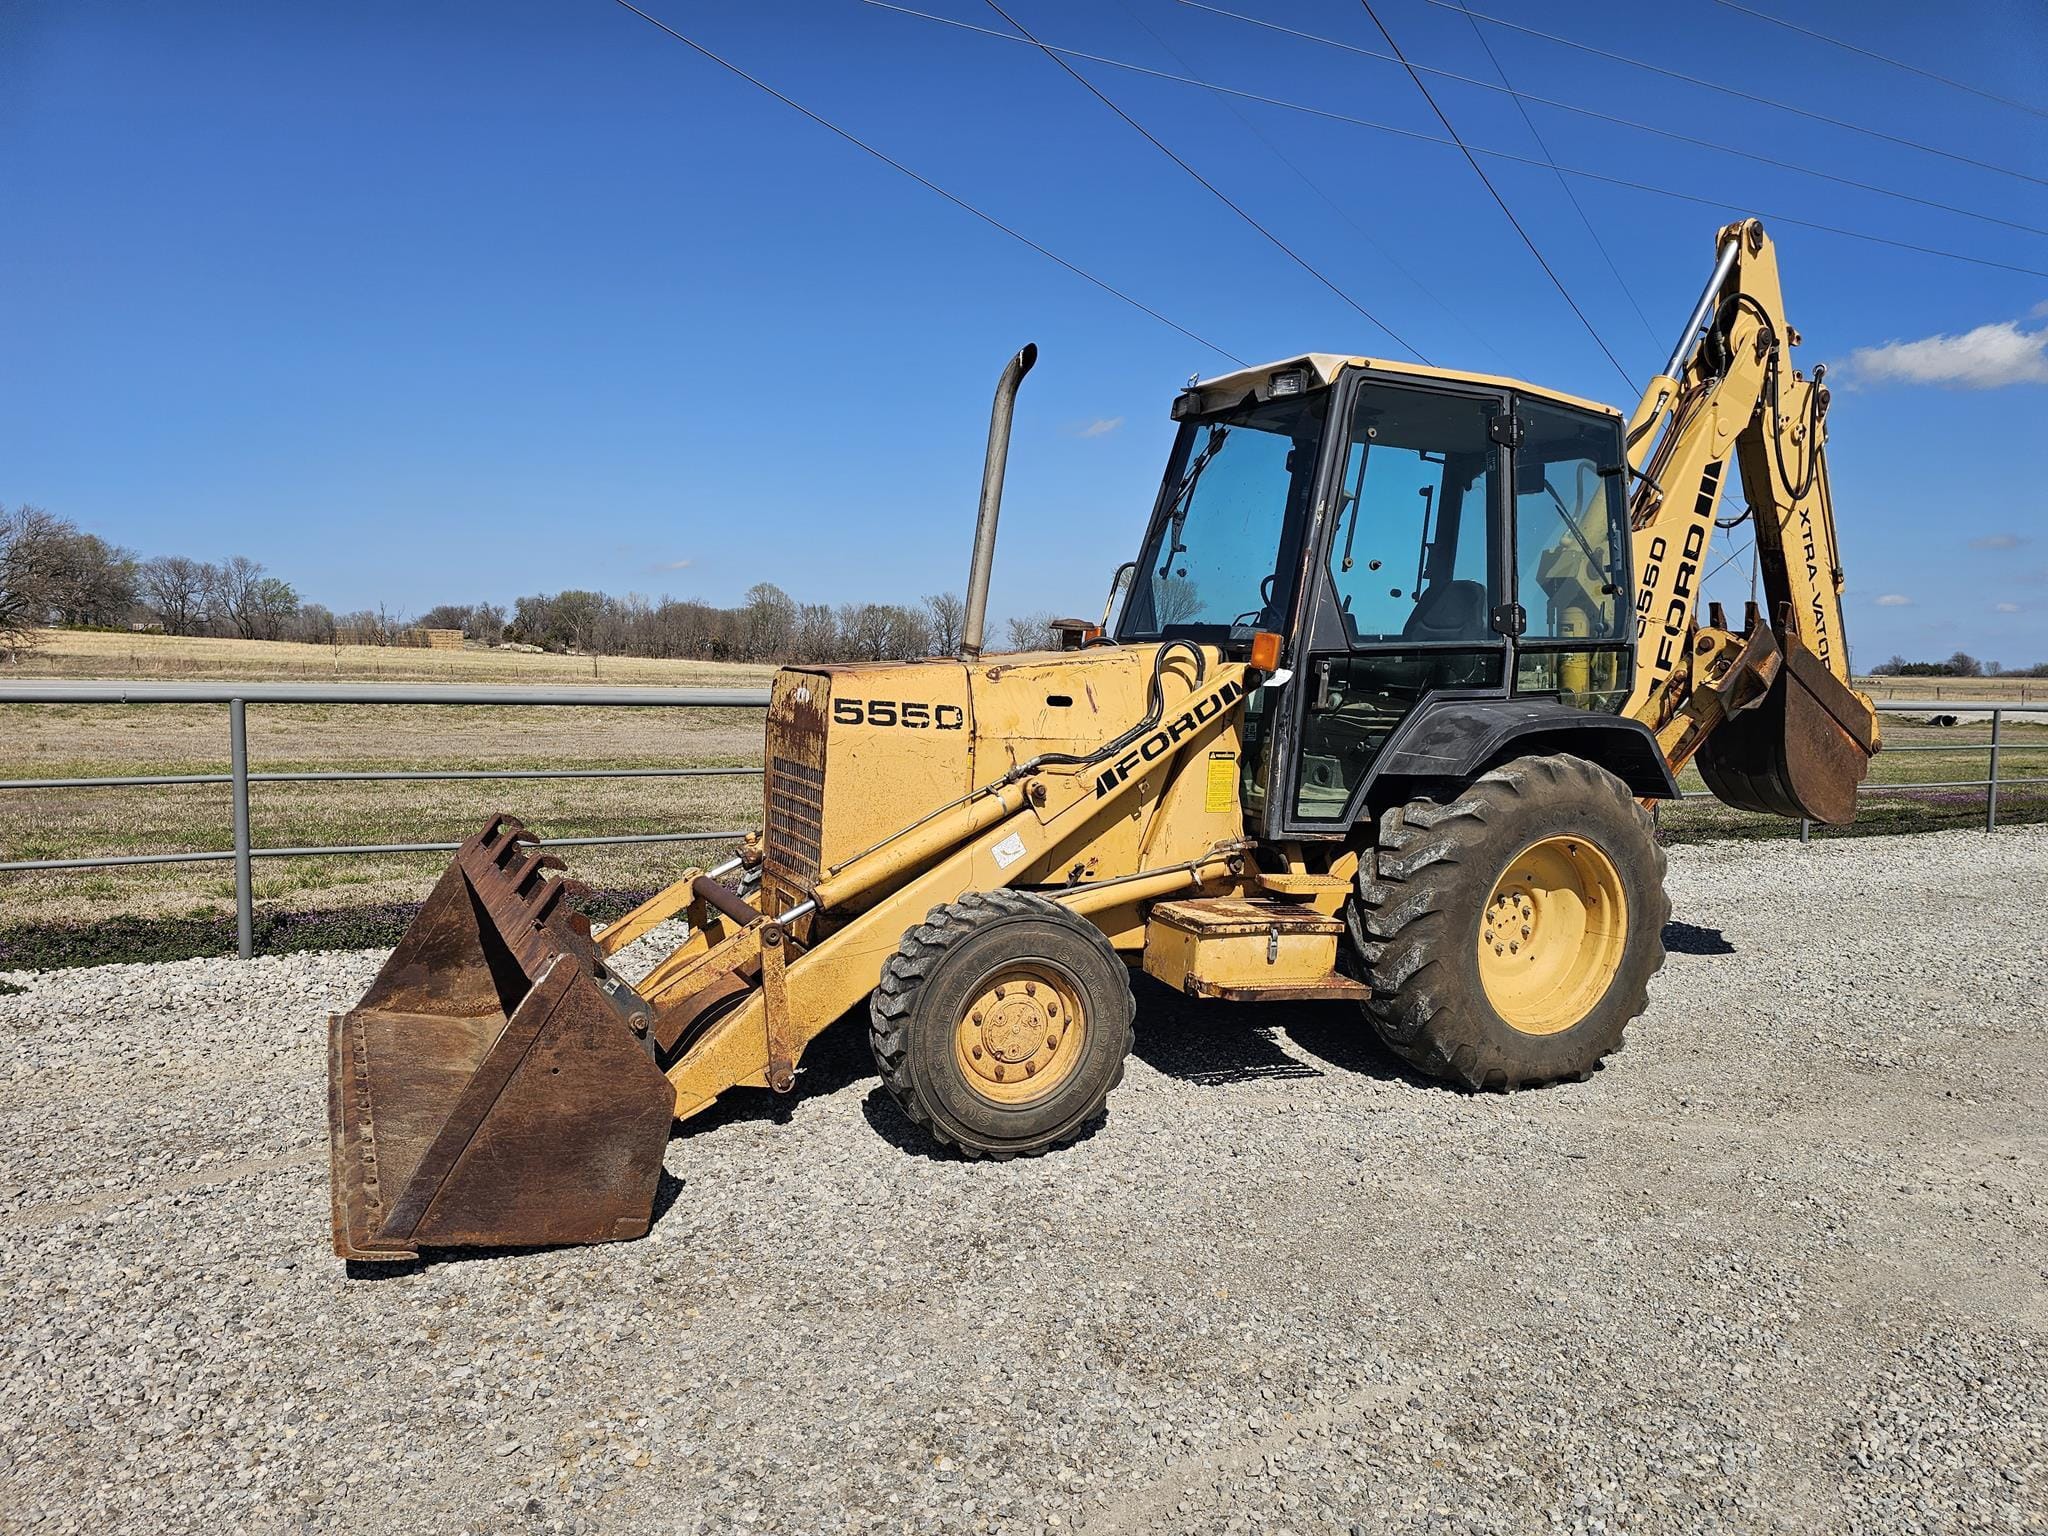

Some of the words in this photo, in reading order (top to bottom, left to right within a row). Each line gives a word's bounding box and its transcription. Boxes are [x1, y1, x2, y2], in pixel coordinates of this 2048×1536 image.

[1655, 523, 1705, 672] FORD
[833, 698, 964, 730] 555D
[1113, 694, 1223, 781] FORD
